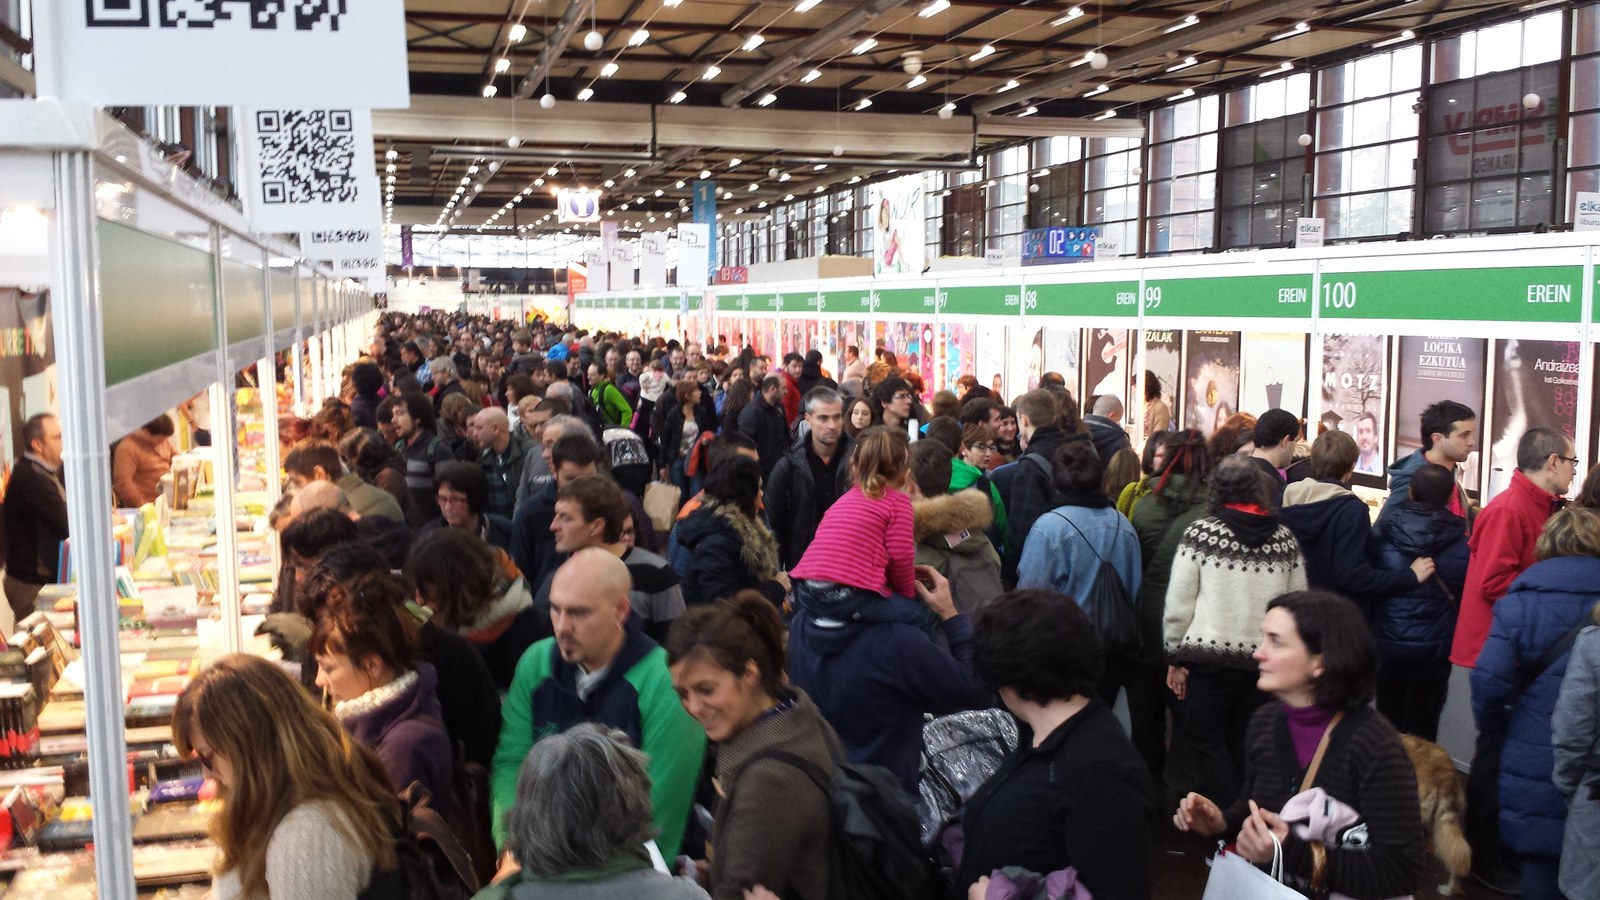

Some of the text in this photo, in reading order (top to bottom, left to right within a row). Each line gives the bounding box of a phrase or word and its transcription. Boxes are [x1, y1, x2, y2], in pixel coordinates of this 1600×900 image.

[1300, 224, 1321, 232] elkar
[1049, 229, 1065, 254] 02
[1025, 290, 1037, 309] 98
[1116, 292, 1136, 305] EREIN
[1145, 286, 1161, 309] 99
[1278, 288, 1306, 303] EREIN
[1323, 282, 1356, 308] 100
[1527, 284, 1571, 303] EREIN
[1424, 341, 1462, 354] LOGIKA
[1419, 354, 1466, 368] EZKUTUA
[1534, 358, 1579, 372] Andraizea
[1324, 371, 1379, 391] MOTZ
